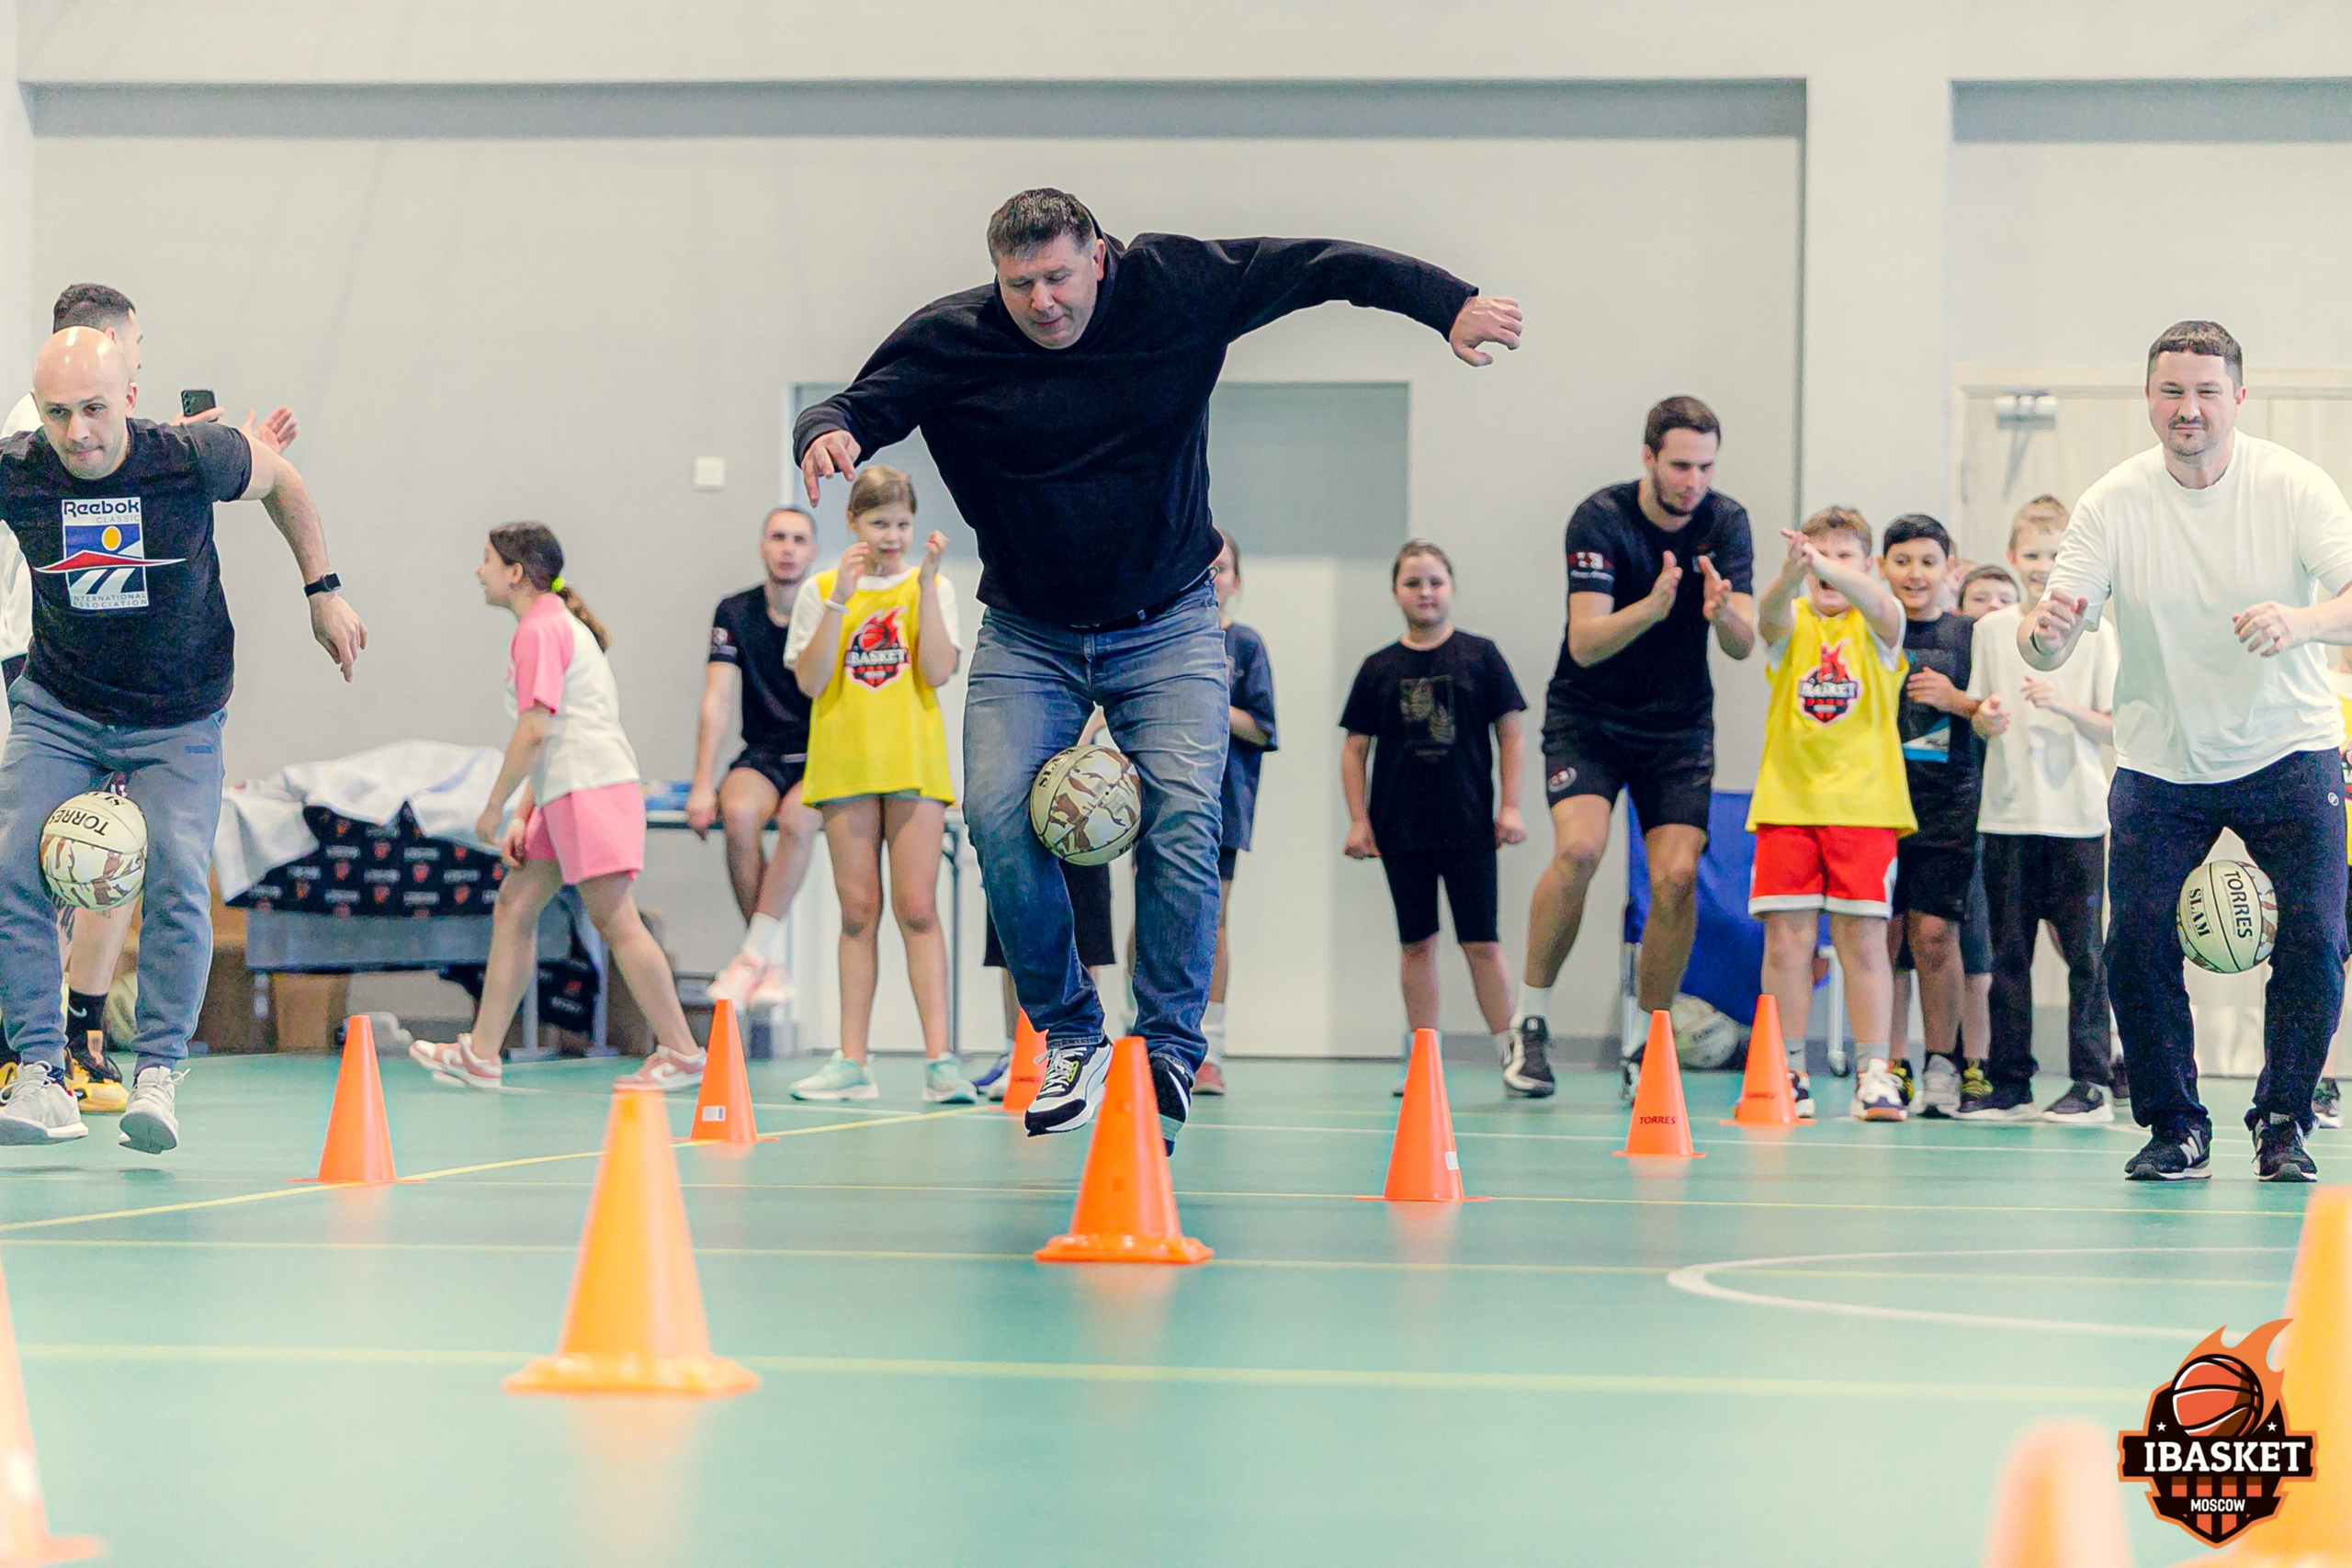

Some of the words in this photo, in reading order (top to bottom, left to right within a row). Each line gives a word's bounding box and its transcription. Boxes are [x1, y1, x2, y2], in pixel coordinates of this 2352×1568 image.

[63, 499, 140, 518] Reebok
[96, 514, 140, 524] CLASSIC
[73, 599, 147, 608] ASSOCIATION
[2224, 870, 2253, 939] TORRES
[2189, 887, 2211, 937] SLAM
[1639, 1116, 1677, 1125] TORRES
